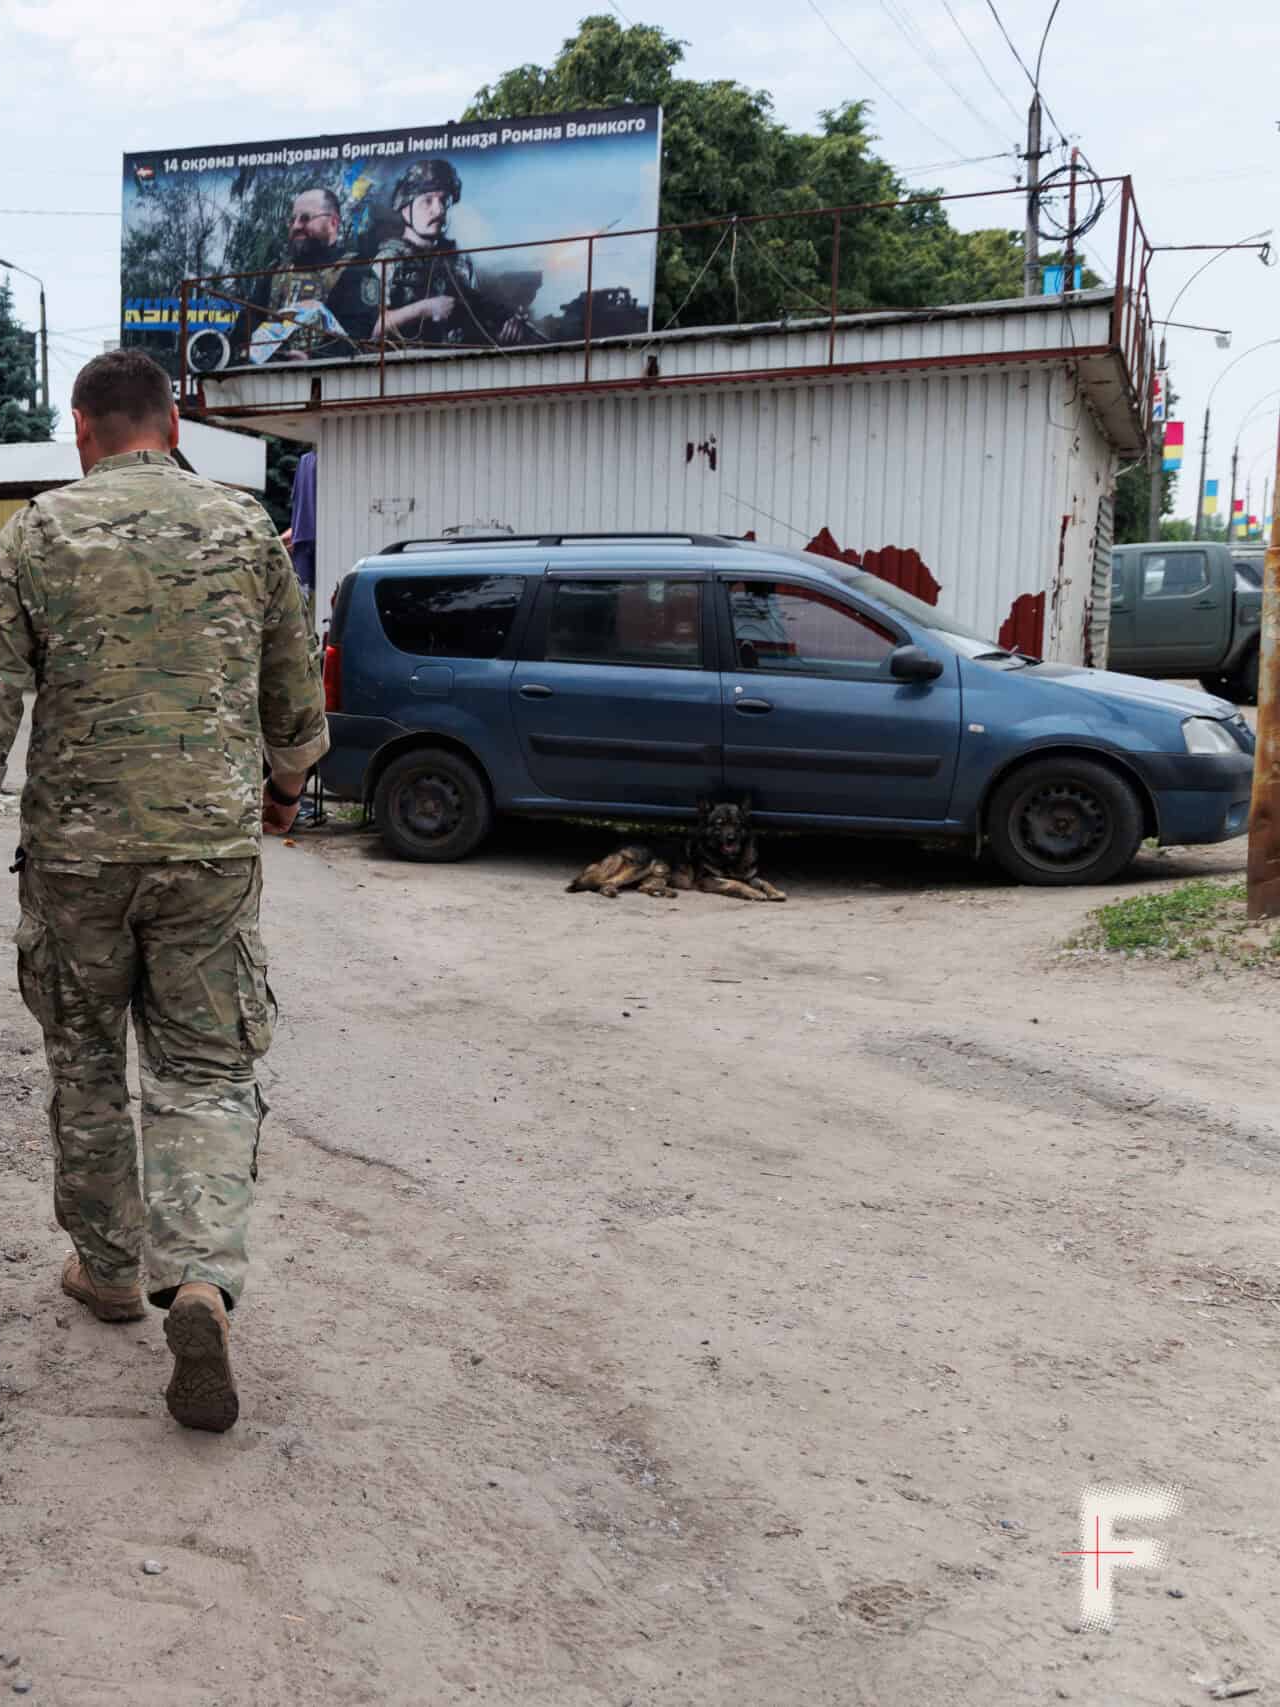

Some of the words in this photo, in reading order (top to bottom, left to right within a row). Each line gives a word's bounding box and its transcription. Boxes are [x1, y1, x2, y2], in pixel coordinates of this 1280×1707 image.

[163, 157, 179, 173] 14
[181, 154, 235, 172] окрема
[237, 145, 338, 167] механізована
[342, 139, 405, 160] бригада
[408, 134, 448, 153] імені
[452, 131, 498, 149] князя
[501, 125, 562, 145] Романа
[566, 117, 647, 138] Великого
